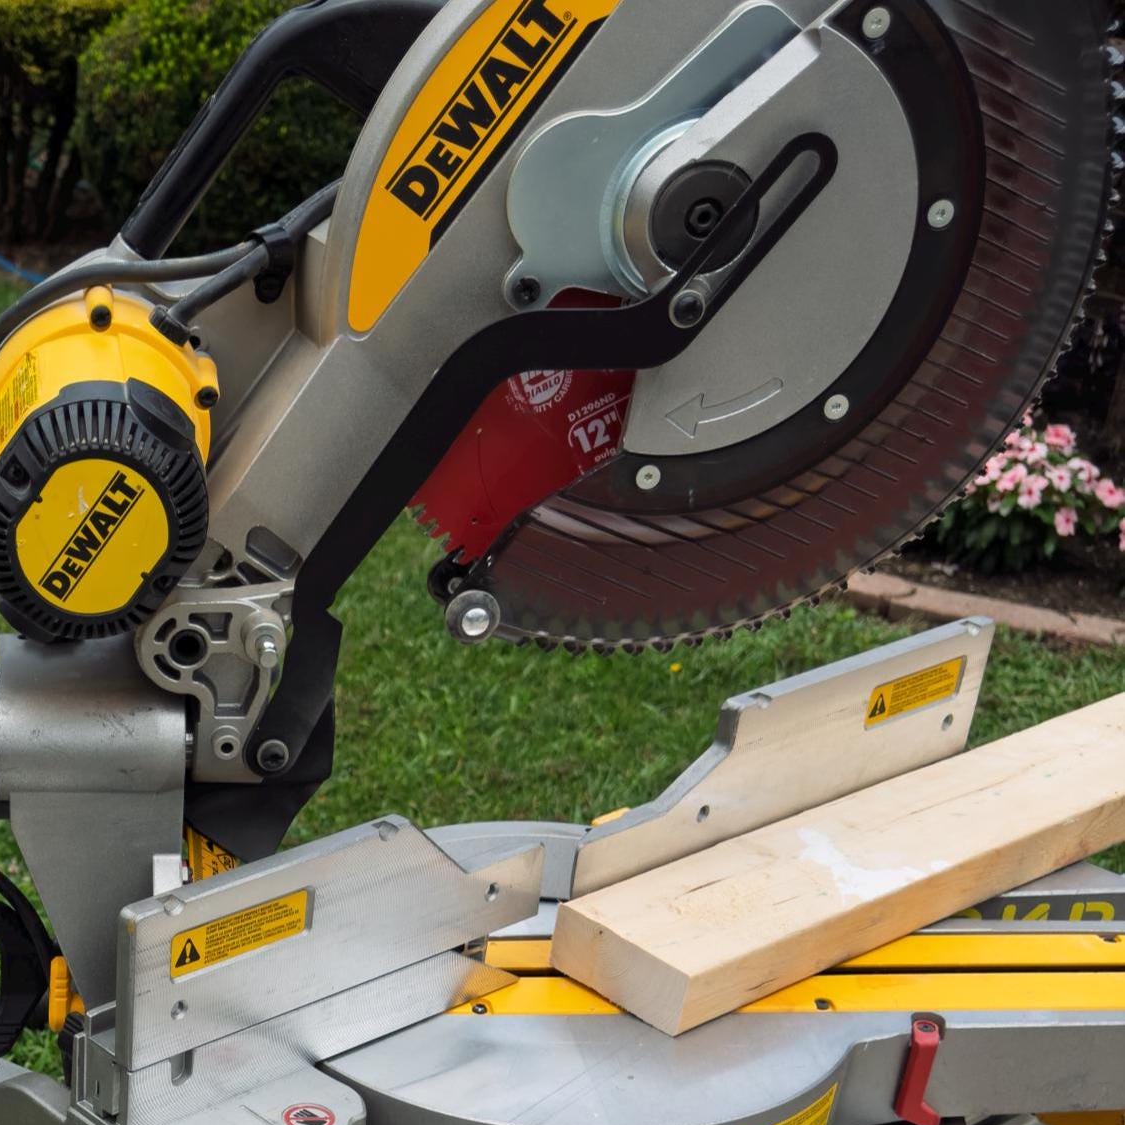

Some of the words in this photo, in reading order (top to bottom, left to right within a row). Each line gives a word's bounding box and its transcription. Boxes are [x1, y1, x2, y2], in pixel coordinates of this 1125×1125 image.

[390, 0, 566, 217] DEWALT
[526, 374, 562, 400] IABLO
[574, 411, 617, 453] 12"
[42, 472, 138, 600] DEWALT
